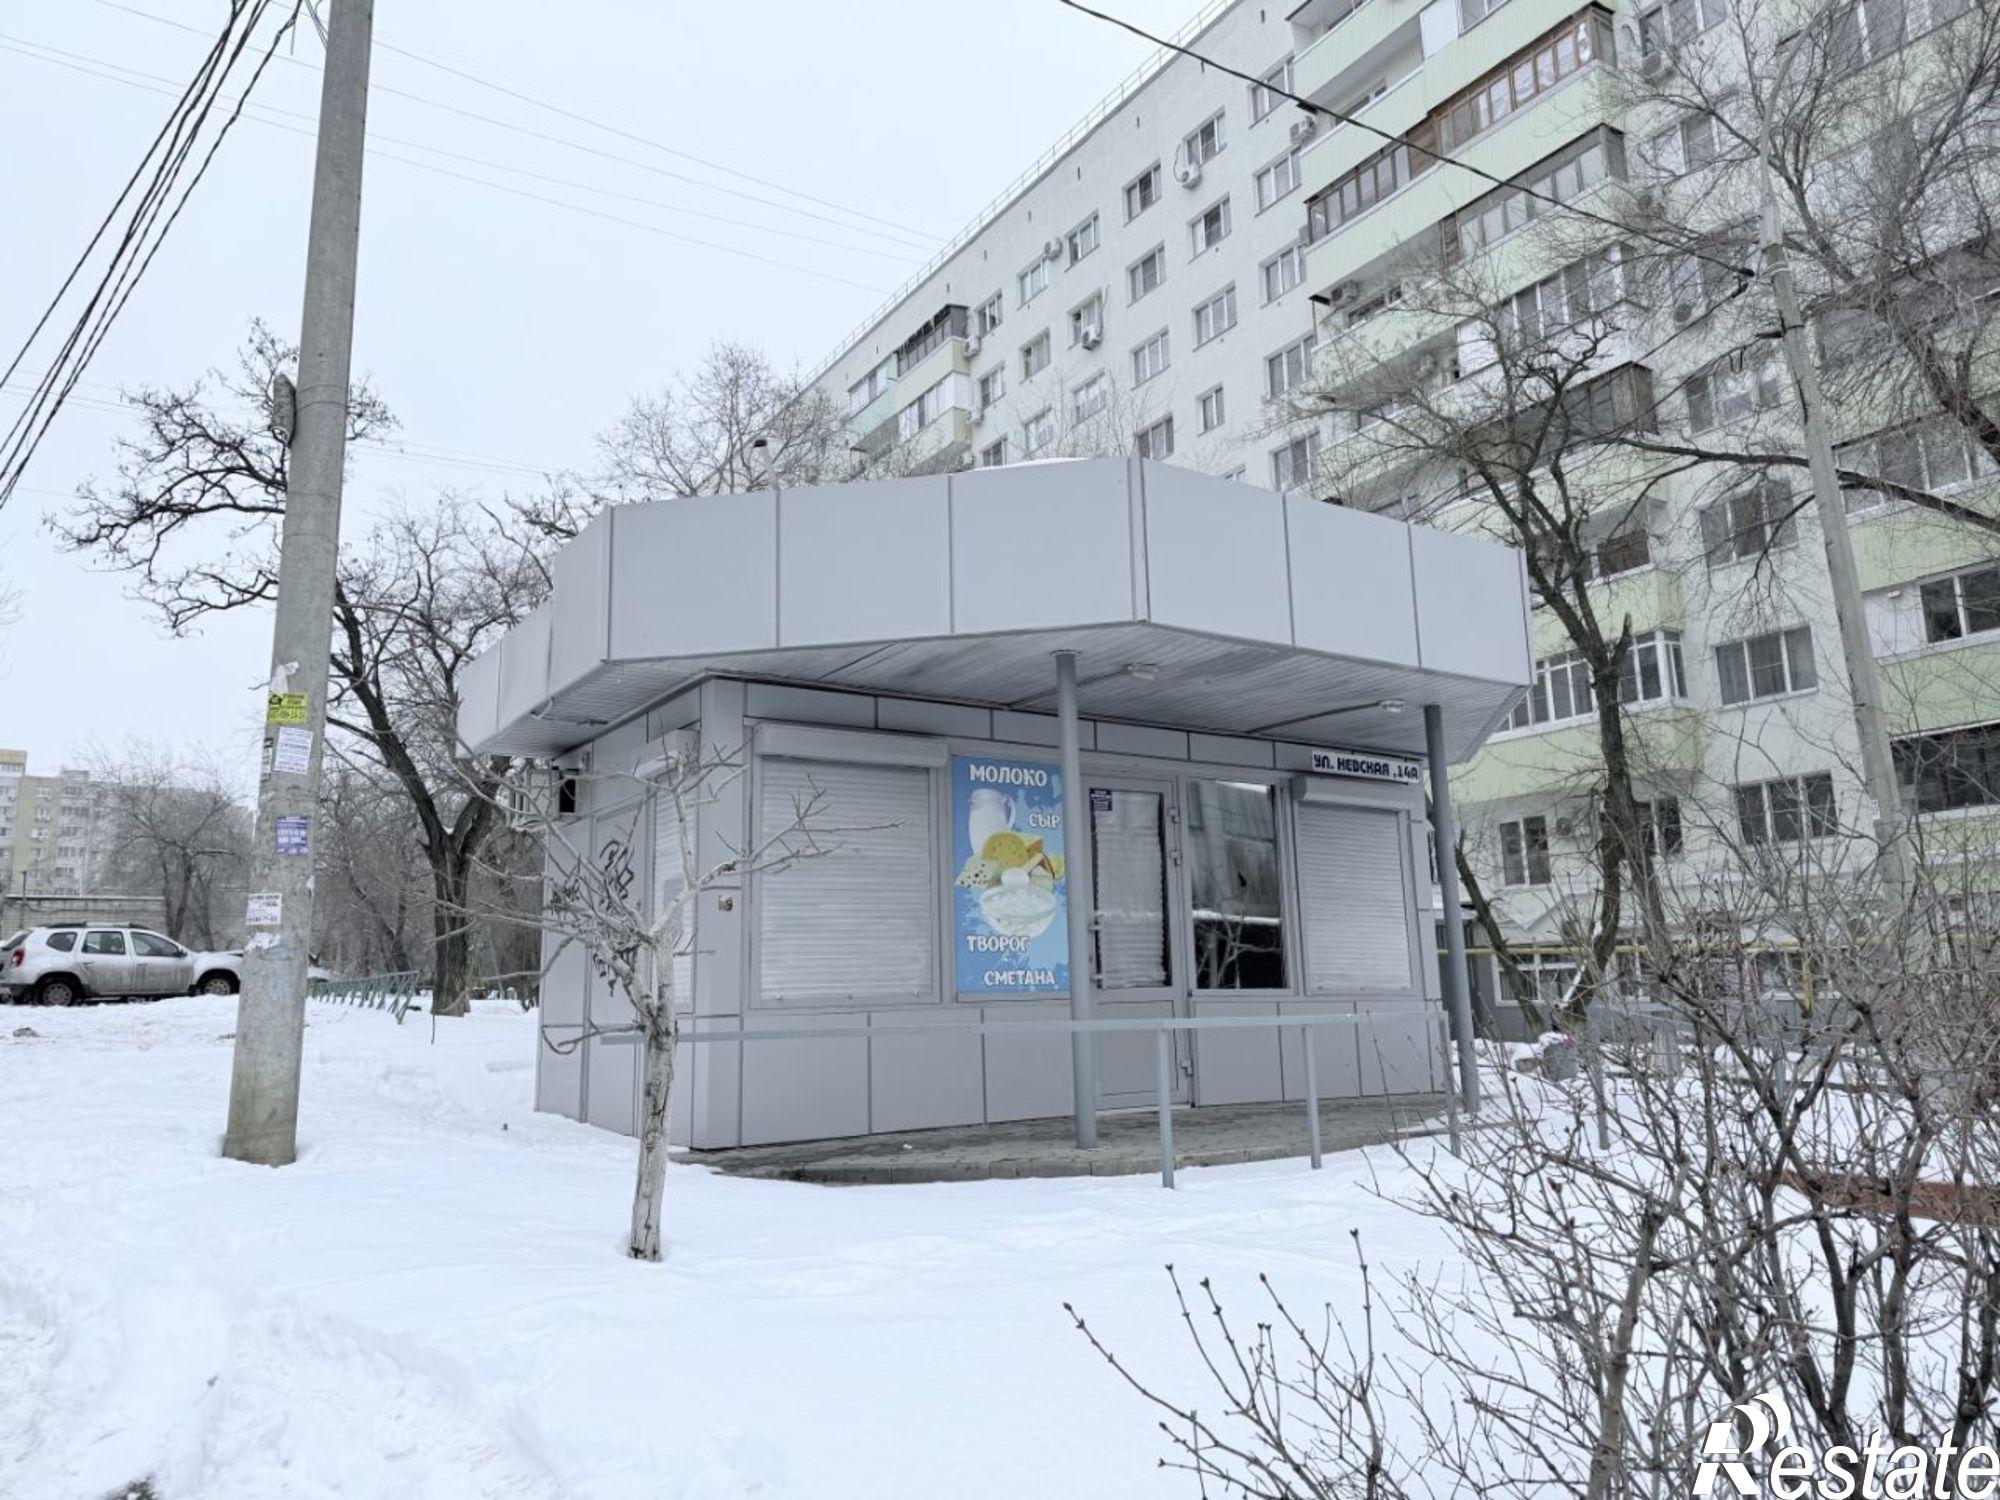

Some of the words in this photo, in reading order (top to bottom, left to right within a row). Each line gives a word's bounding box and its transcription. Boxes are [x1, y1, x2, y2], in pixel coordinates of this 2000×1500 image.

[1313, 754, 1334, 769] УЛ.
[1337, 757, 1390, 776] НЕВСКАЯ
[969, 764, 1048, 787] МОЛОКО
[1029, 812, 1061, 828] СЫР
[966, 935, 1029, 952] ТВОРОГ
[984, 970, 1056, 986] СМЕТАНА
